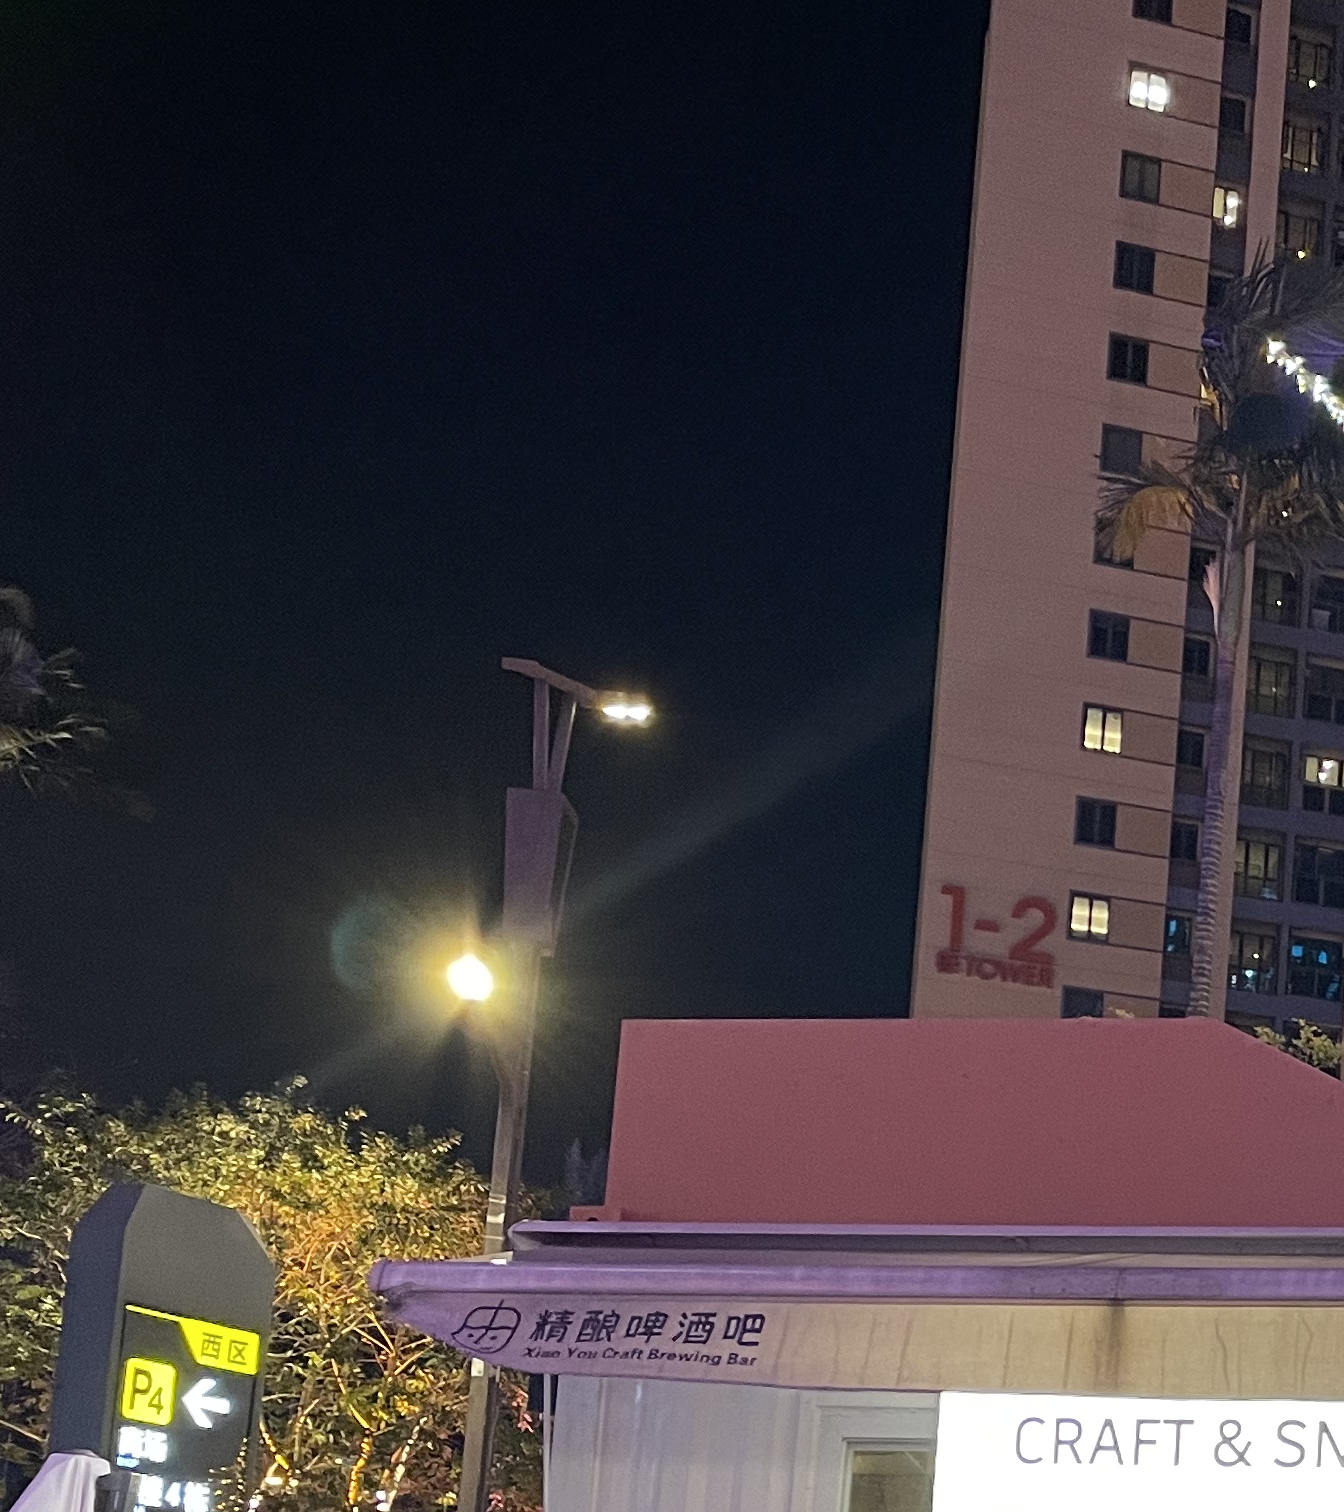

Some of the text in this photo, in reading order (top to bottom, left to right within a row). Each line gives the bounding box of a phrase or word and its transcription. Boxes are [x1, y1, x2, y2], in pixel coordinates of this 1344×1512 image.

[940, 883, 1058, 965] 1-2
[201, 1331, 249, 1366] 西区
[530, 1309, 767, 1347] 精酿啤酒吧
[524, 1347, 758, 1367] Xiao You Craft Brewing Bar
[128, 1366, 164, 1416] P4
[1014, 1416, 1195, 1467] CRAFT
[1213, 1418, 1253, 1468] &
